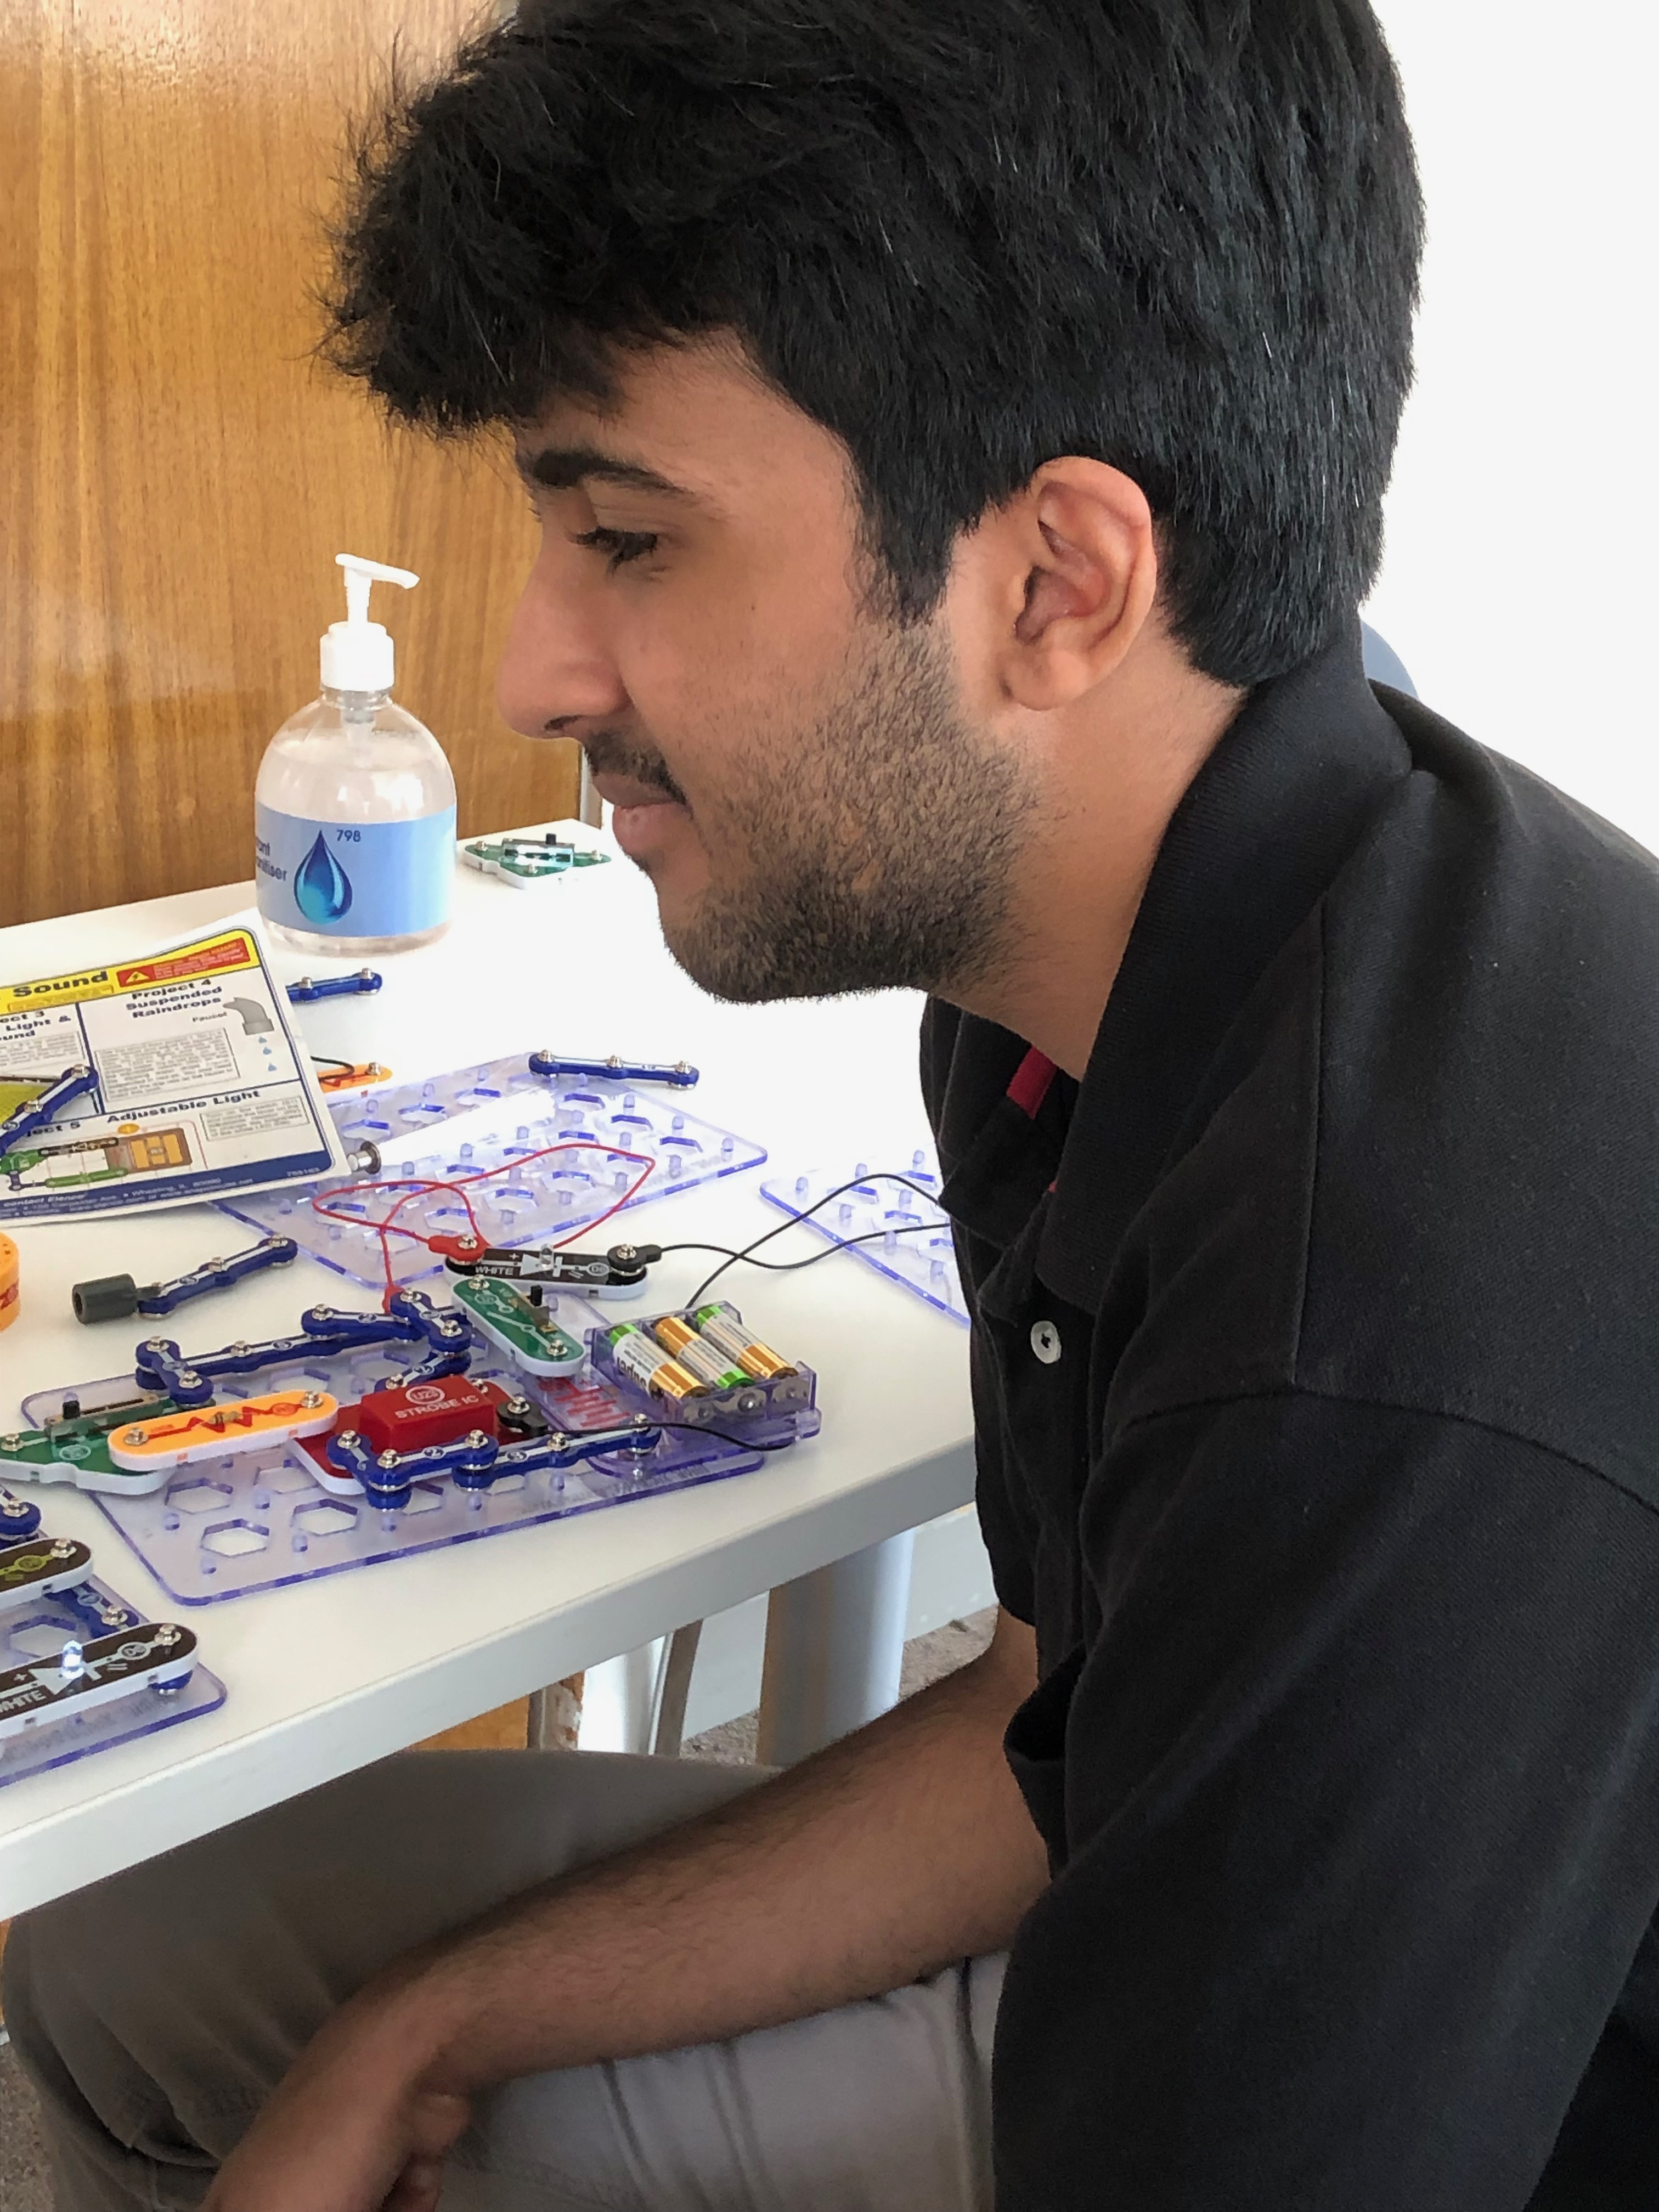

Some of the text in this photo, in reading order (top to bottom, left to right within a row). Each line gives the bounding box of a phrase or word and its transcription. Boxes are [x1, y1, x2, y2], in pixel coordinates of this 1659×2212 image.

[336, 829, 362, 842] 798
[13, 970, 108, 997] Sound
[132, 983, 195, 1000] Project
[126, 986, 222, 1011] Suspended
[132, 997, 222, 1018] Raindrops
[5, 1015, 71, 1031] Light &
[0, 1030, 36, 1041] und
[107, 1099, 207, 1123] Adjustable
[213, 1091, 261, 1105] Light
[475, 1266, 515, 1276] WHITE
[394, 1394, 479, 1419] STROBE IC
